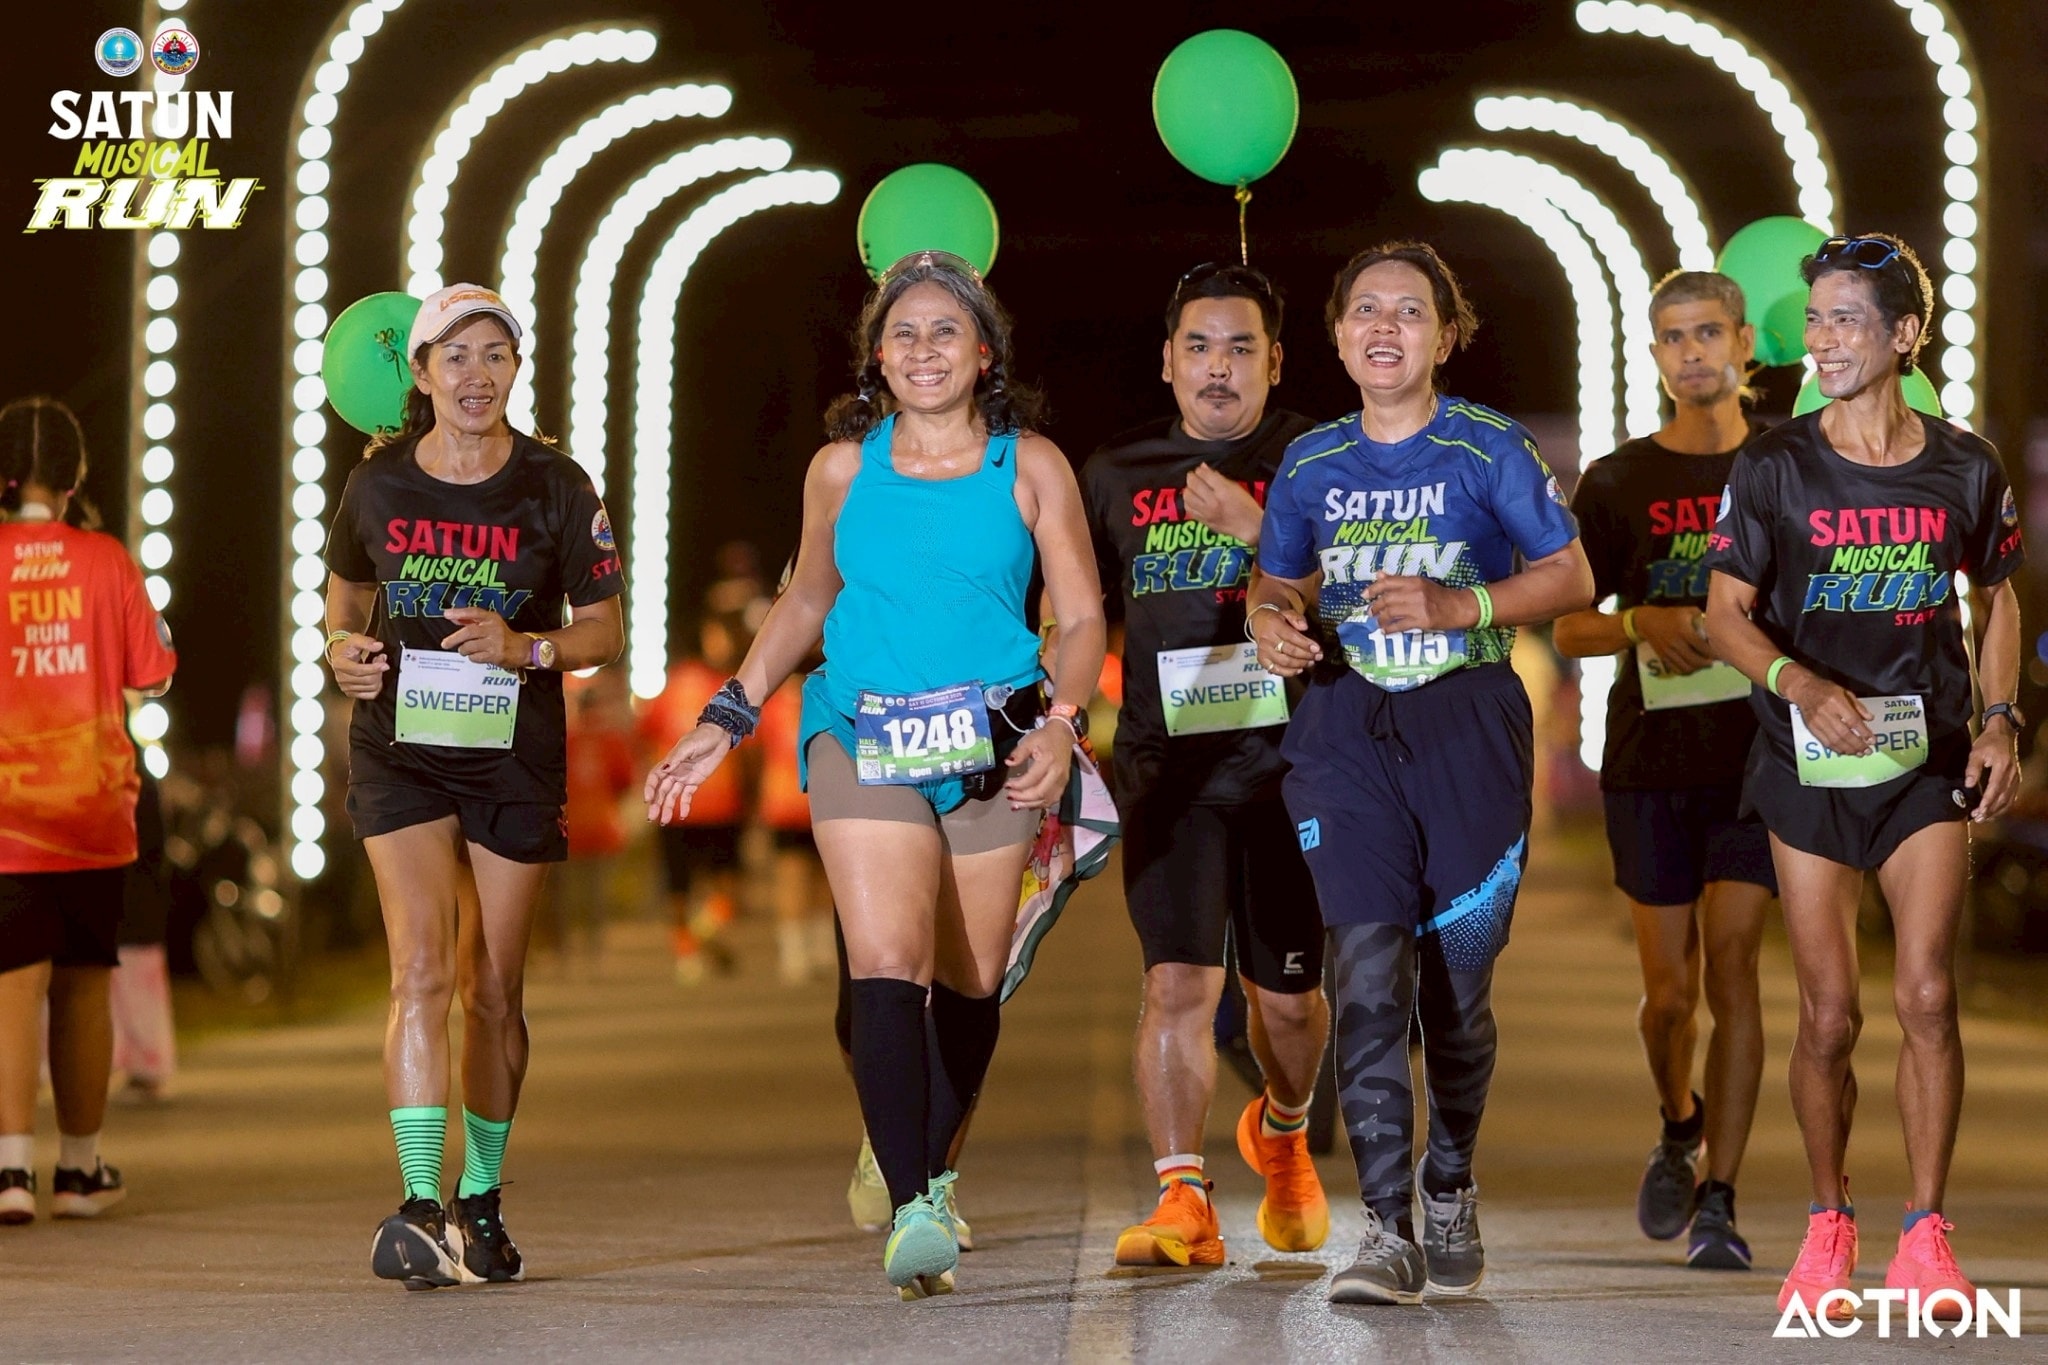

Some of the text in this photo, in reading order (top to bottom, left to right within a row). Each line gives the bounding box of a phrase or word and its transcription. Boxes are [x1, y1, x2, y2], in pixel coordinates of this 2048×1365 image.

[1325, 482, 1447, 522] SATUN
[385, 518, 520, 562] SATUN
[1333, 517, 1438, 546] MUSICAL
[1809, 508, 1947, 547] SATUN
[399, 554, 506, 588] MUSICAL
[1318, 541, 1471, 588] RUN
[1829, 541, 1935, 574] MUSICAL
[8, 586, 82, 625] FUN
[382, 580, 534, 620] RUN
[1801, 571, 1950, 614] RUN
[25, 622, 70, 645] RUN
[1368, 628, 1449, 667] 1175
[482, 676, 518, 687] RUN
[1170, 680, 1277, 708] SWEEPER
[1386, 677, 1408, 687] Open
[404, 689, 511, 715] SWEEPER
[860, 705, 887, 715] RUN
[1883, 710, 1921, 722] RUN
[1884, 699, 1917, 708] SATUN
[883, 709, 976, 758] 1248
[885, 764, 896, 778] F
[908, 767, 932, 778] Open
